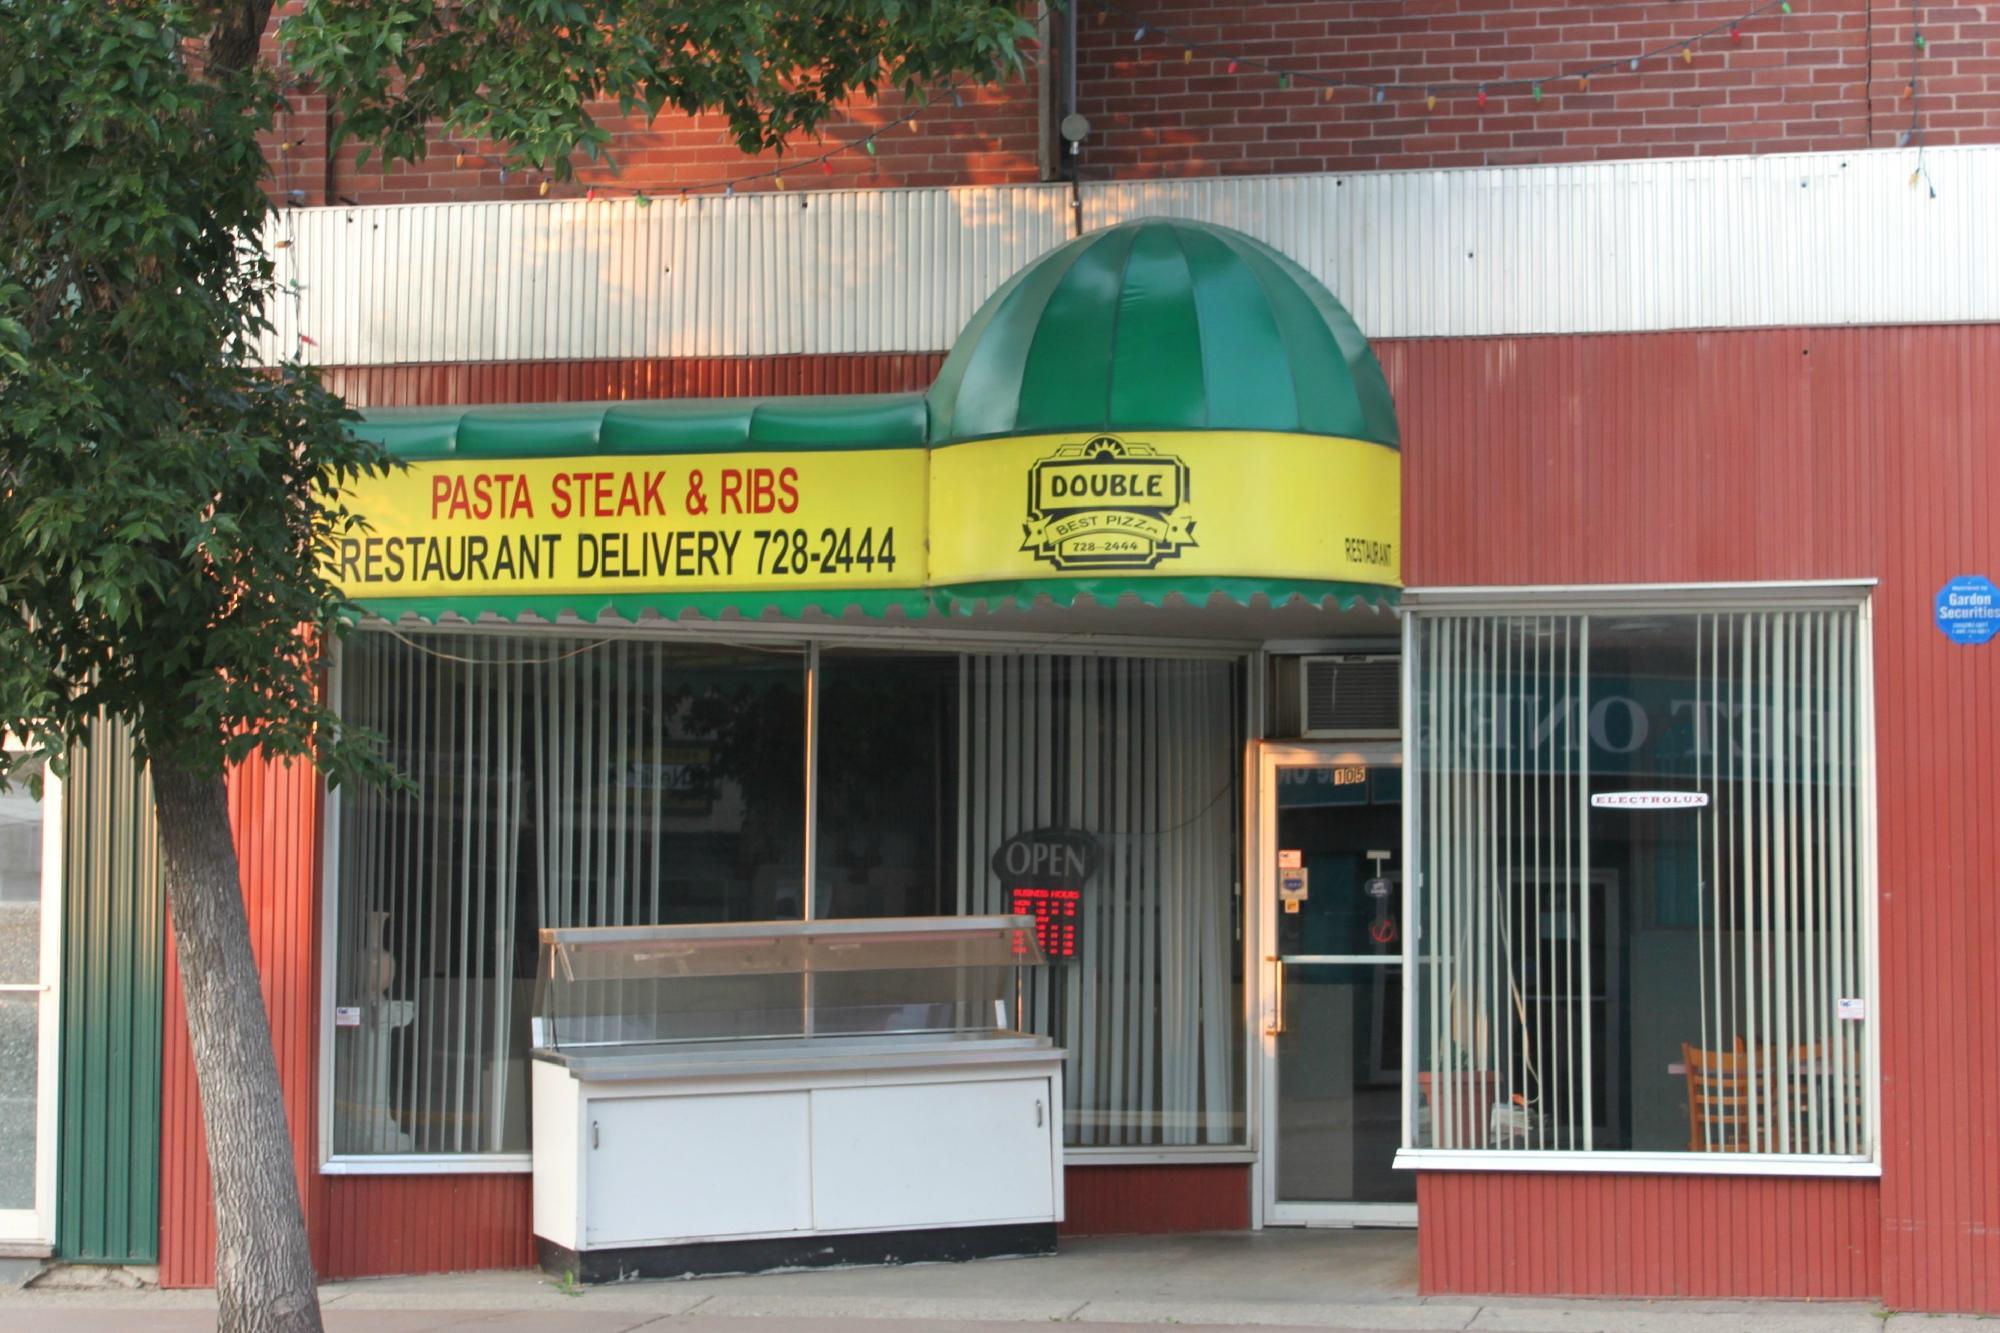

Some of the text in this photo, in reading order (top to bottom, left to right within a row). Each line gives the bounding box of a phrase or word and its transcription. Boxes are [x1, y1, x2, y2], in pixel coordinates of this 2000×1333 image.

[433, 467, 799, 520] PASTA STEAK & RIBS
[1052, 475, 1163, 498] DOUBLE
[1056, 516, 1098, 536] BEST
[341, 527, 896, 582] RESTAURANT DELIVERY 728-2444
[1334, 768, 1366, 785] 105
[1596, 796, 1704, 804] ELECTROLUX
[1006, 841, 1085, 877] OPEN
